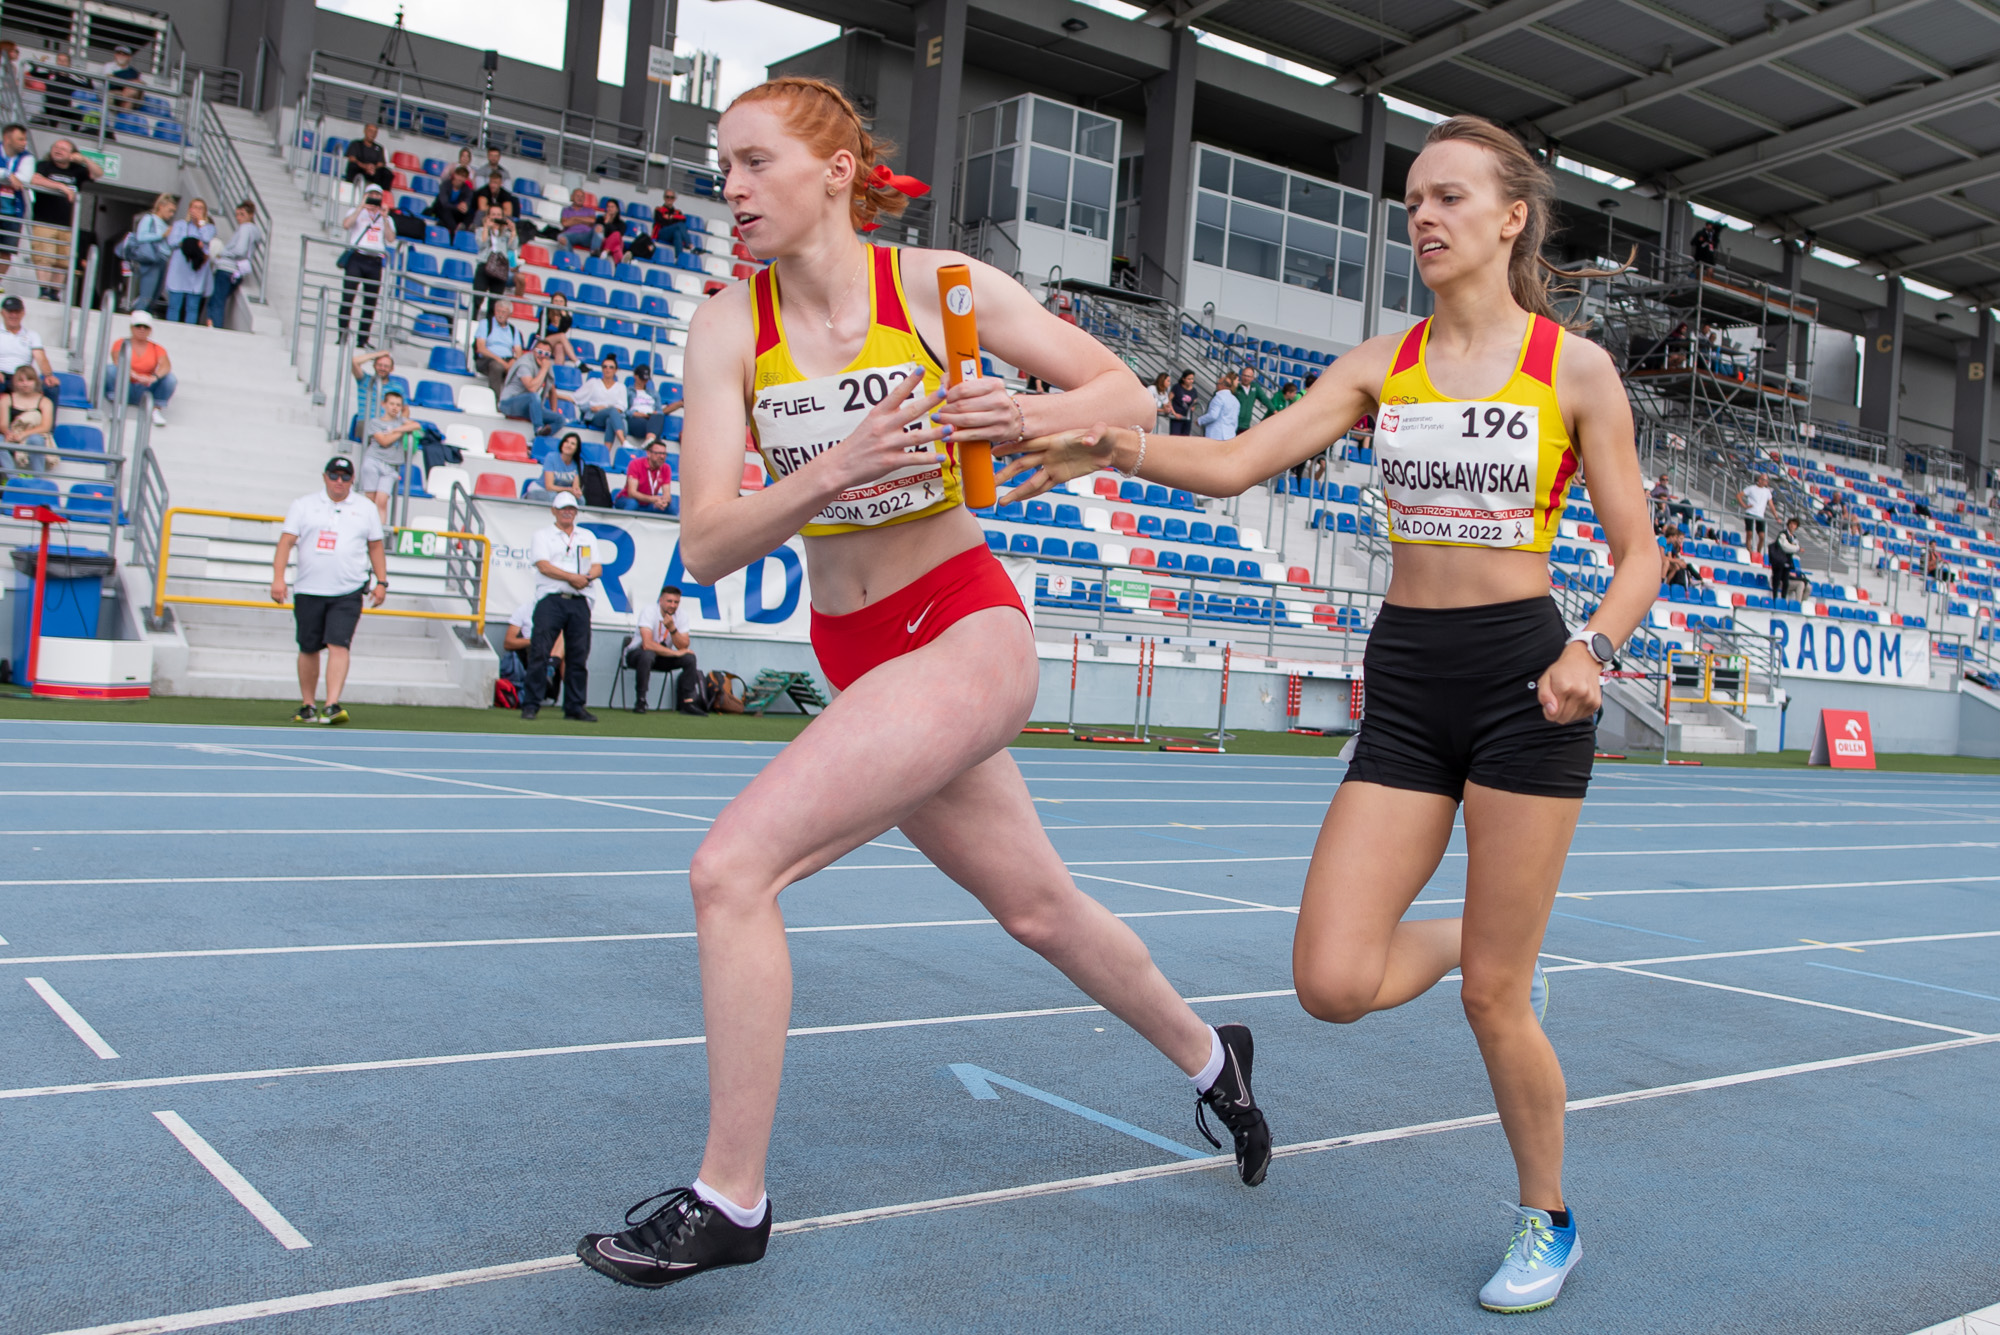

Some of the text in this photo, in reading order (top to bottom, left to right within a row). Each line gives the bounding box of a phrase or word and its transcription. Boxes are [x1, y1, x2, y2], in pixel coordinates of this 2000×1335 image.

[927, 35, 942, 68] E
[1877, 334, 1893, 353] C
[1968, 362, 1984, 381] B
[772, 396, 826, 418] FUEL
[1461, 407, 1528, 440] 196
[877, 477, 915, 493] POLSKI
[917, 471, 939, 480] U20
[1381, 458, 1530, 493] BOGUSŁAWSKA
[816, 492, 914, 520] ADOM 2022
[1405, 506, 1473, 517] MISTRZOSTWA
[1474, 510, 1508, 520] POLSKI
[1510, 509, 1531, 518] U20
[1458, 524, 1502, 540] 2022
[400, 531, 436, 556] A-8
[1769, 618, 1903, 678] RADOM
[1838, 742, 1864, 753] ORLEN
